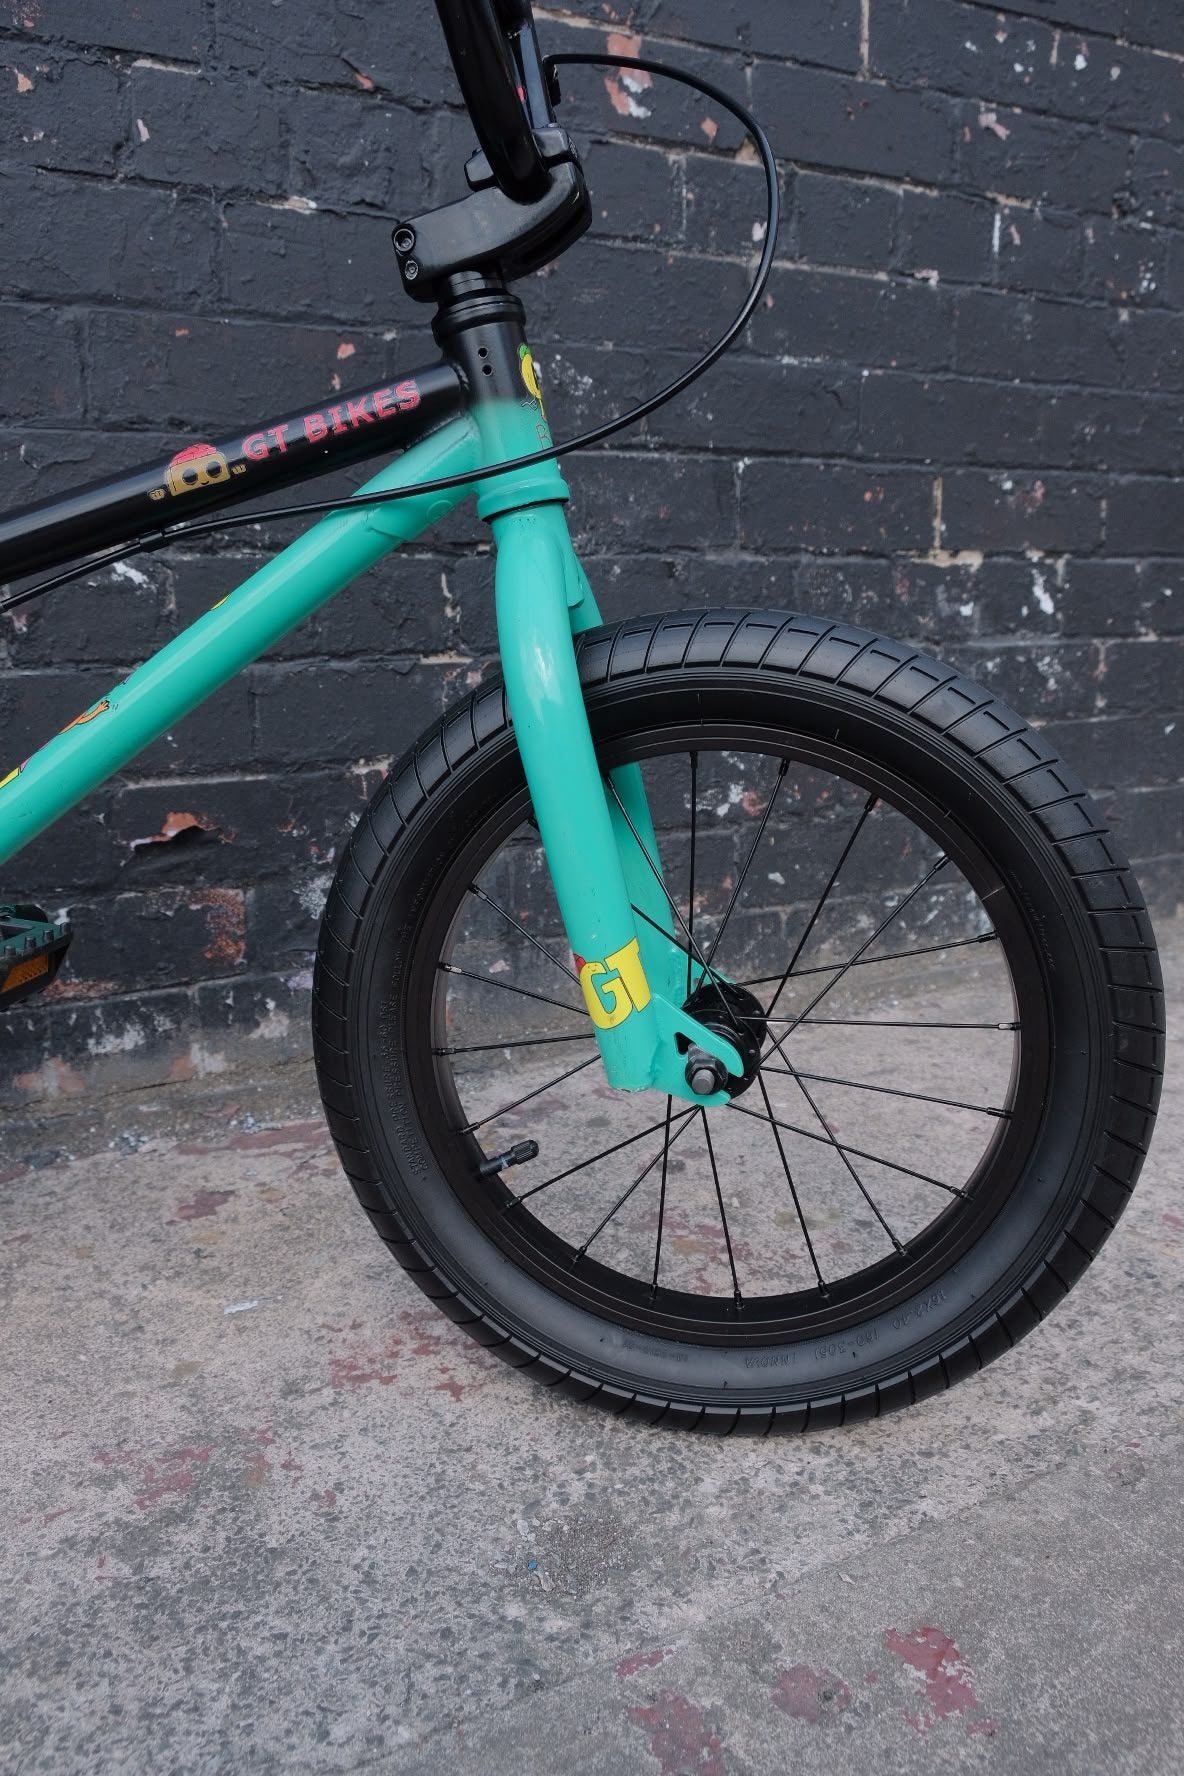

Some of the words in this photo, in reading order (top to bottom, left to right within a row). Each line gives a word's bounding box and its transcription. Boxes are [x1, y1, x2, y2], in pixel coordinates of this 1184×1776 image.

[242, 424, 289, 460] GT
[303, 380, 421, 443] BIKES
[579, 936, 651, 1030] GT
